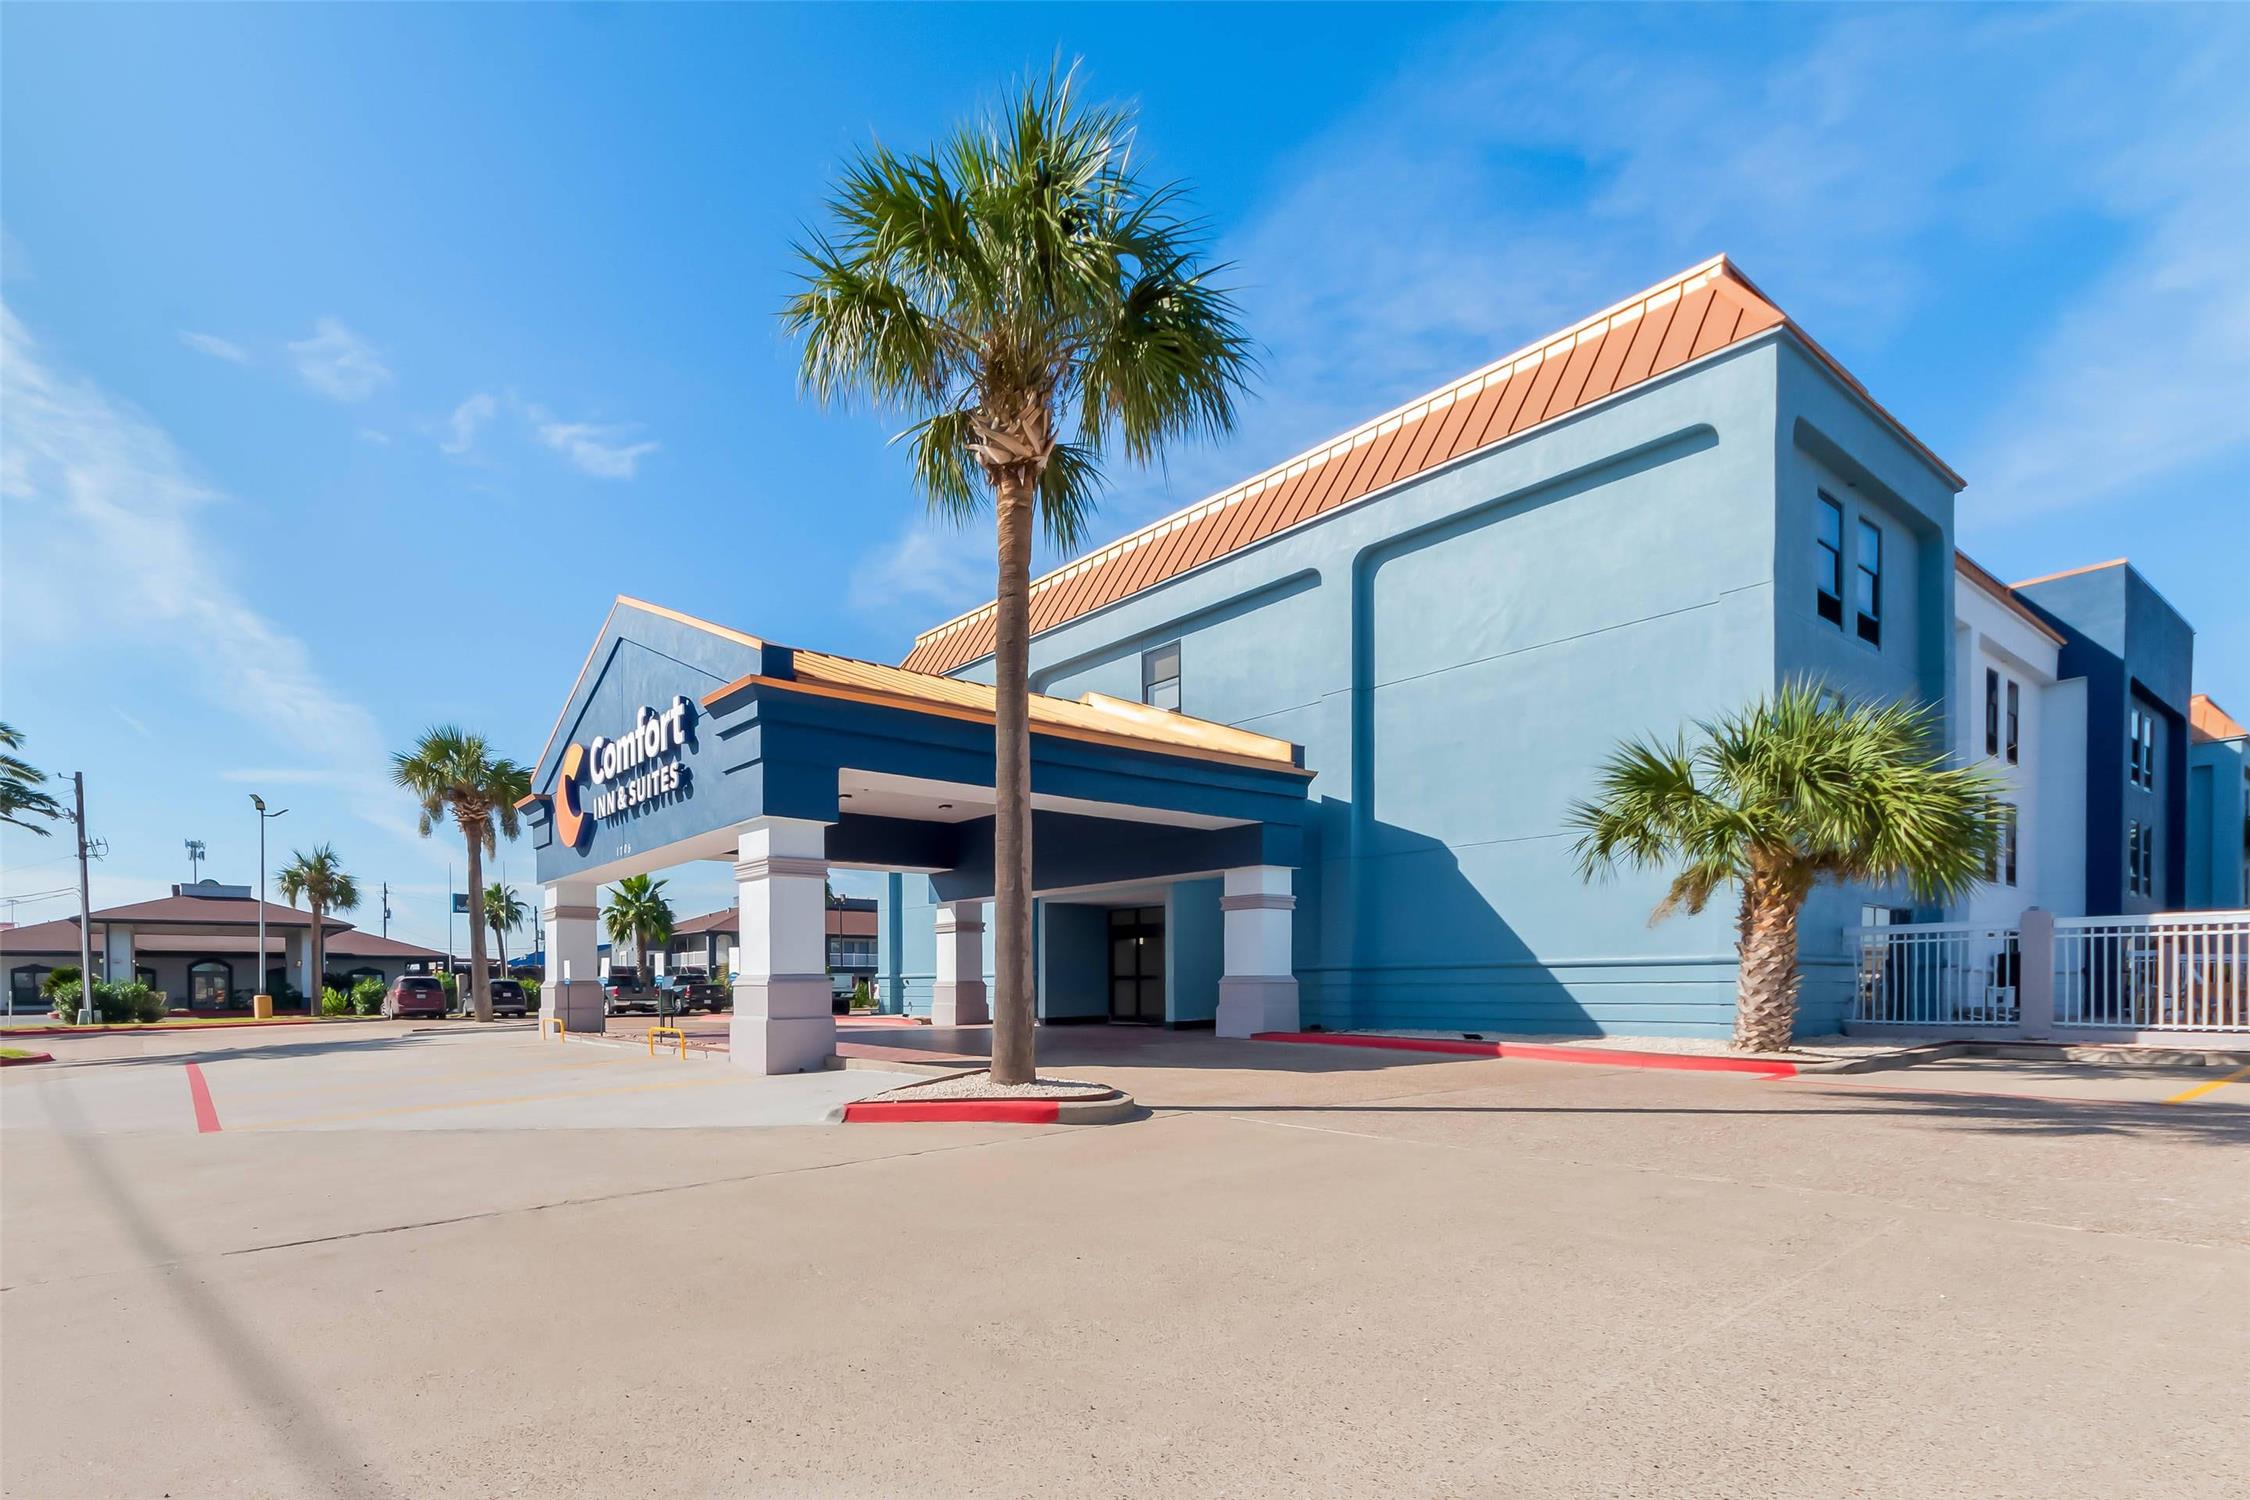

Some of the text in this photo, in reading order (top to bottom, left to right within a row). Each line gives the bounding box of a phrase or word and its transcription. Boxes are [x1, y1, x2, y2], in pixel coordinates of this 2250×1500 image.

[589, 695, 686, 785] Comfort
[593, 761, 680, 821] INN & SUITES
